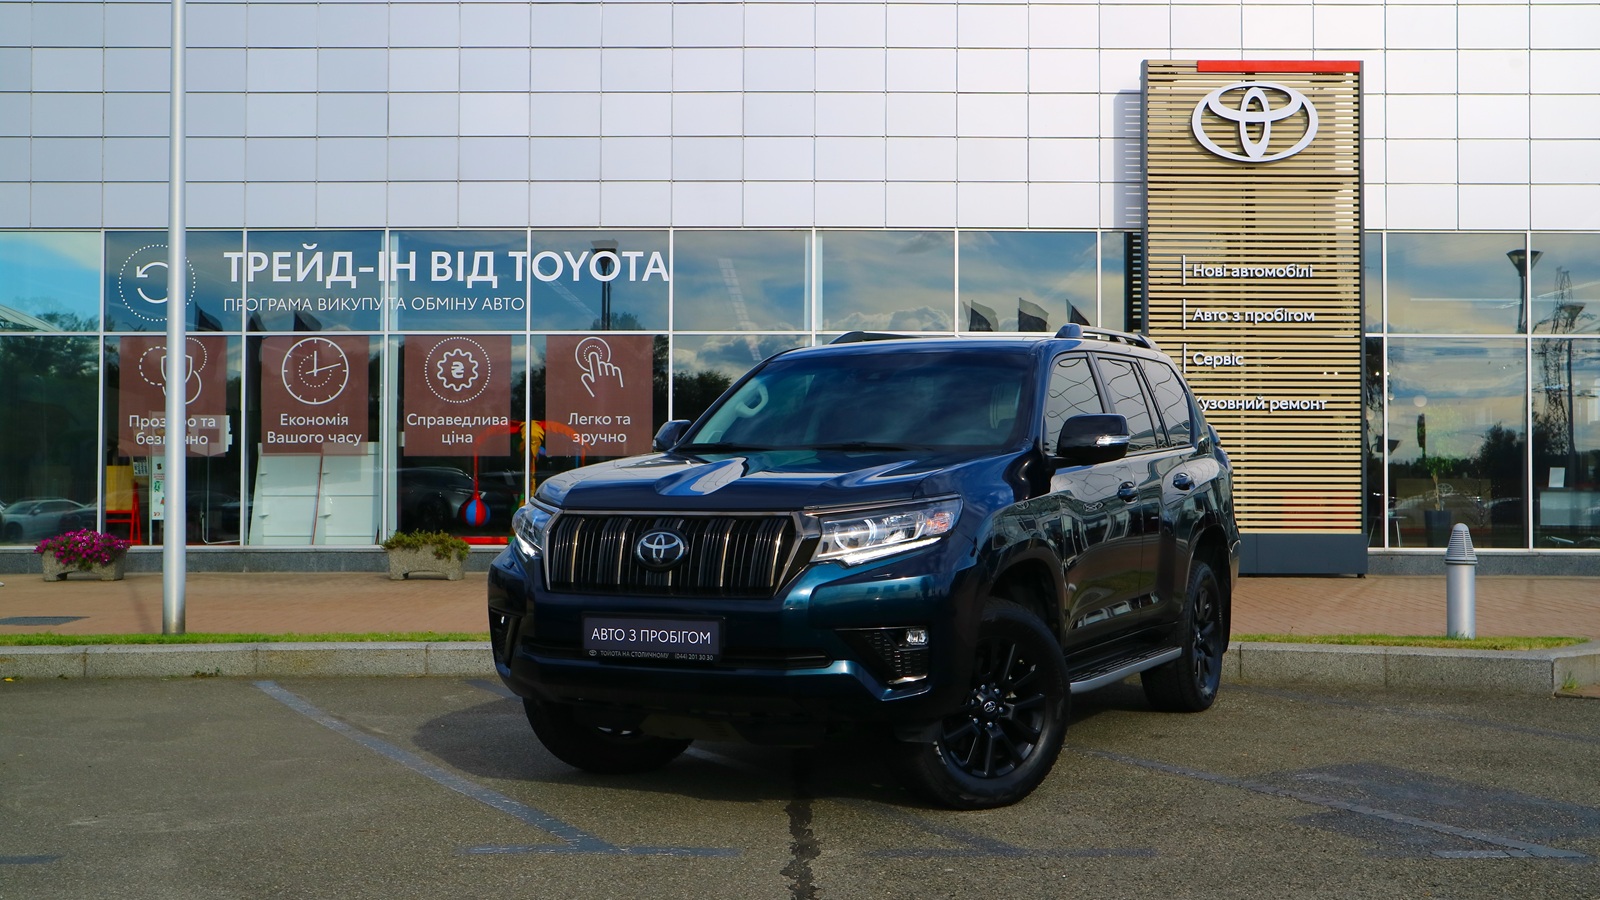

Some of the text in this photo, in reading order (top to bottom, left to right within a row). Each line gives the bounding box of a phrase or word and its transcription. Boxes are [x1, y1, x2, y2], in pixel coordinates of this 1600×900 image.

[223, 243, 669, 289] ТРЕЙД-ІН ВІД TOYOTA
[1193, 264, 1313, 278] Нові автомобілі
[223, 297, 525, 311] ПРОГРАМА ВИКУПУ ТА ОБМІНУ АВТО
[1193, 308, 1315, 325] Авто з пробігом
[1193, 353, 1244, 369] Сервіс
[1270, 400, 1327, 412] ремонт
[129, 415, 216, 430] Прозо та
[280, 414, 349, 426] Економія
[406, 414, 508, 428] Справедлива
[568, 413, 631, 426] Легко та
[136, 432, 209, 445] безно
[267, 432, 362, 447] Вашого часу
[441, 432, 473, 445] ціна
[572, 433, 627, 447] зручно
[591, 628, 711, 644] АВТО З ПРОБІГОМ
